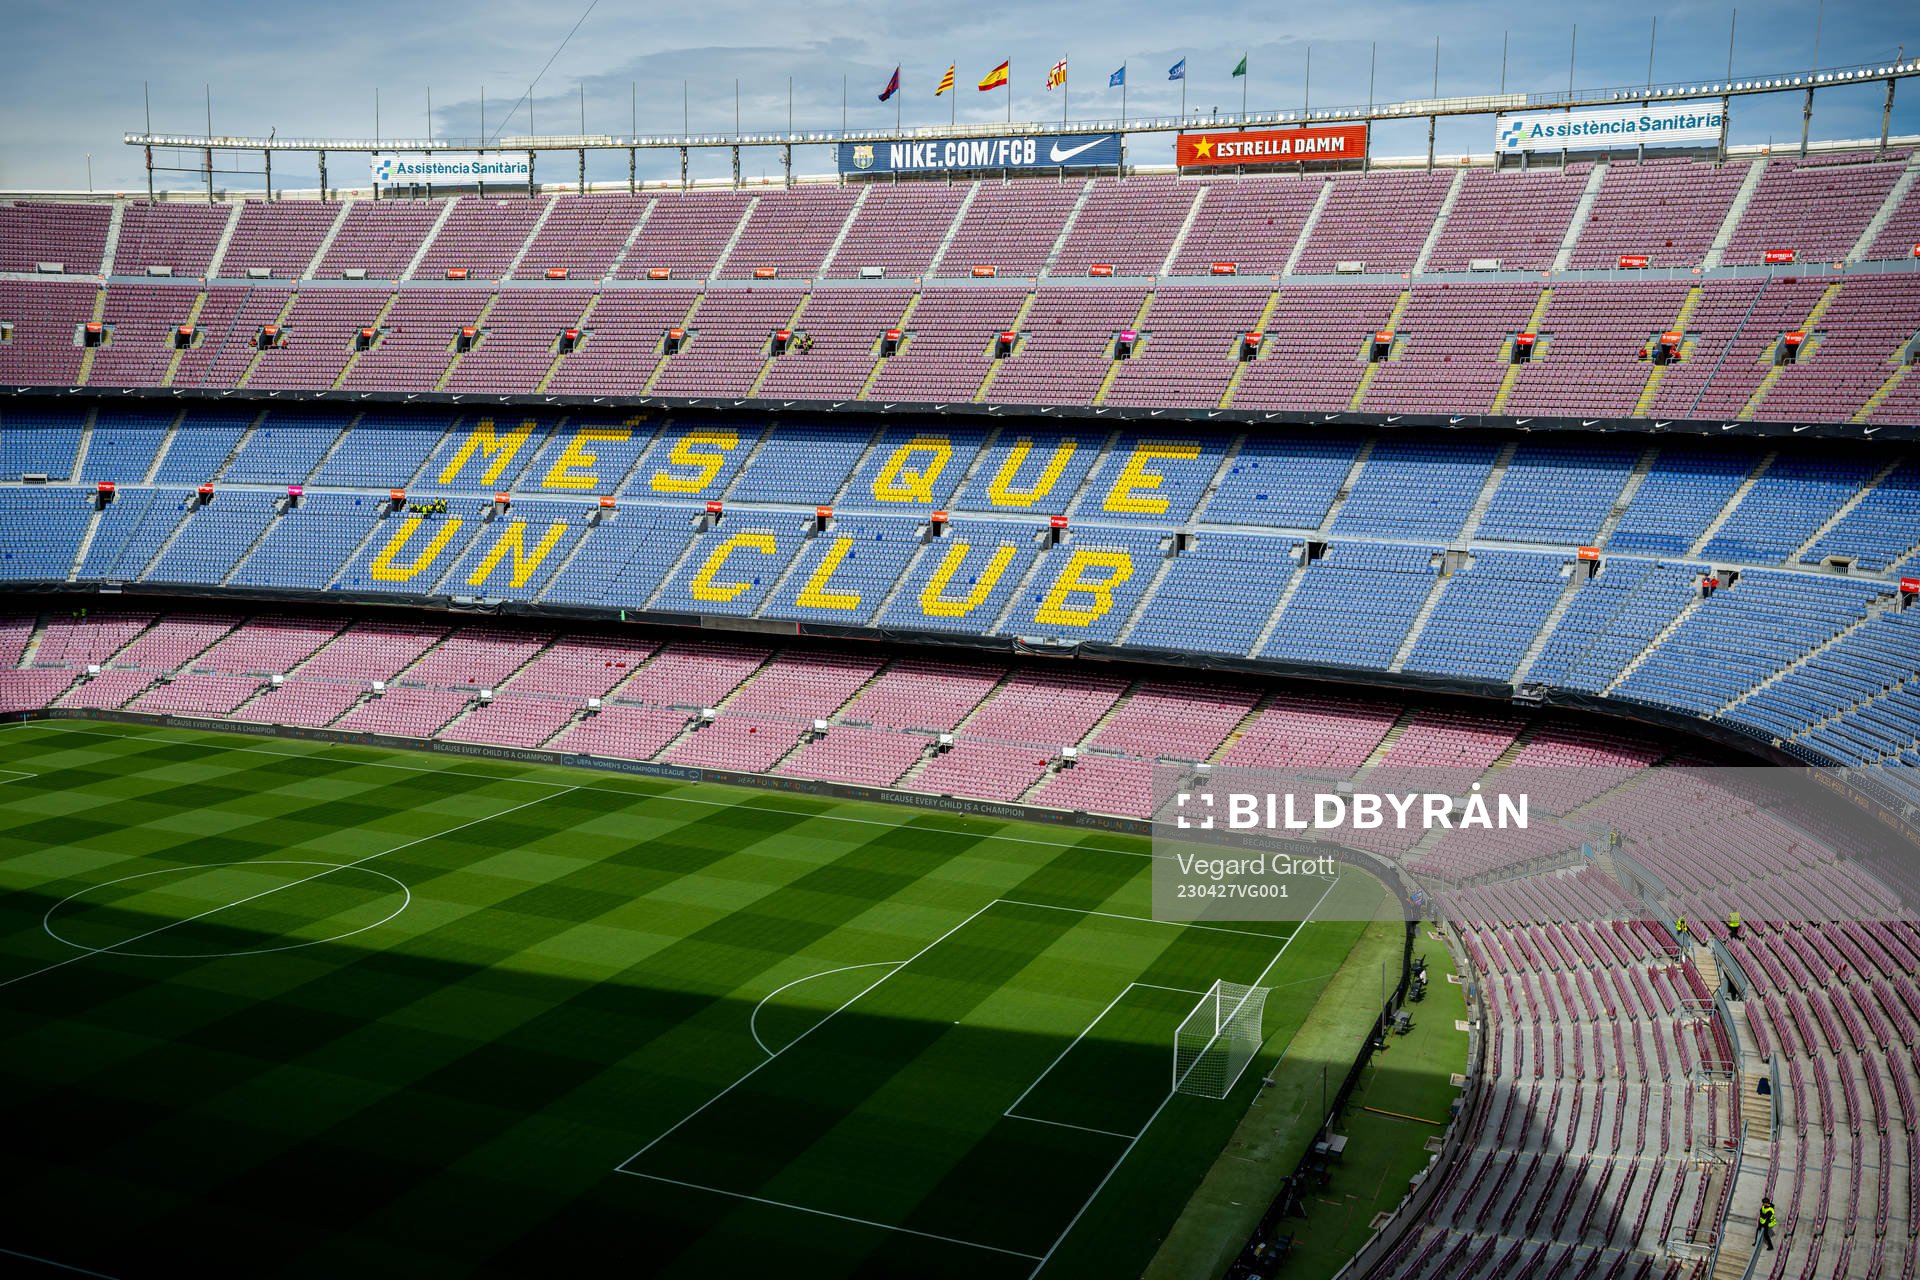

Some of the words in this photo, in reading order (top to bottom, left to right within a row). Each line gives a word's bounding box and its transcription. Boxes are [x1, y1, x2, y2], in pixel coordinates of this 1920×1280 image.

[1530, 118, 1636, 138] Assistència
[1638, 113, 1721, 132] Sanitària
[890, 139, 1036, 168] NIKE.COM/FCB
[1217, 140, 1291, 157] ESTRELLA
[1294, 136, 1345, 153] DAMM
[397, 162, 470, 174] Assistència
[471, 162, 528, 174] Sanitària
[437, 411, 740, 494] MÉS
[872, 438, 1202, 515] QUE
[370, 517, 569, 590] UN
[691, 533, 1135, 629] CLUB
[166, 718, 192, 727] BECAUSE
[193, 720, 211, 729] EVERY
[211, 722, 230, 730] CHILD
[242, 725, 276, 735] CHAMPION
[433, 743, 461, 753] BECAUSE
[462, 746, 482, 755] EVERY
[482, 748, 502, 757] CHILD
[503, 750, 510, 758] IS
[517, 752, 554, 762] CHAMPION
[577, 758, 591, 766] UEFA
[622, 764, 660, 774] CHAMPIONS
[661, 767, 685, 777] LEAGUE
[881, 793, 913, 804] BECAUSE
[915, 796, 938, 806] EVERY
[939, 799, 962, 809] CHILD
[963, 802, 972, 811] IS
[980, 804, 1025, 817] CHAMPION
[1242, 837, 1282, 850] BECAUSE
[1284, 842, 1311, 853] EVERY
[1313, 846, 1340, 857] CHILD
